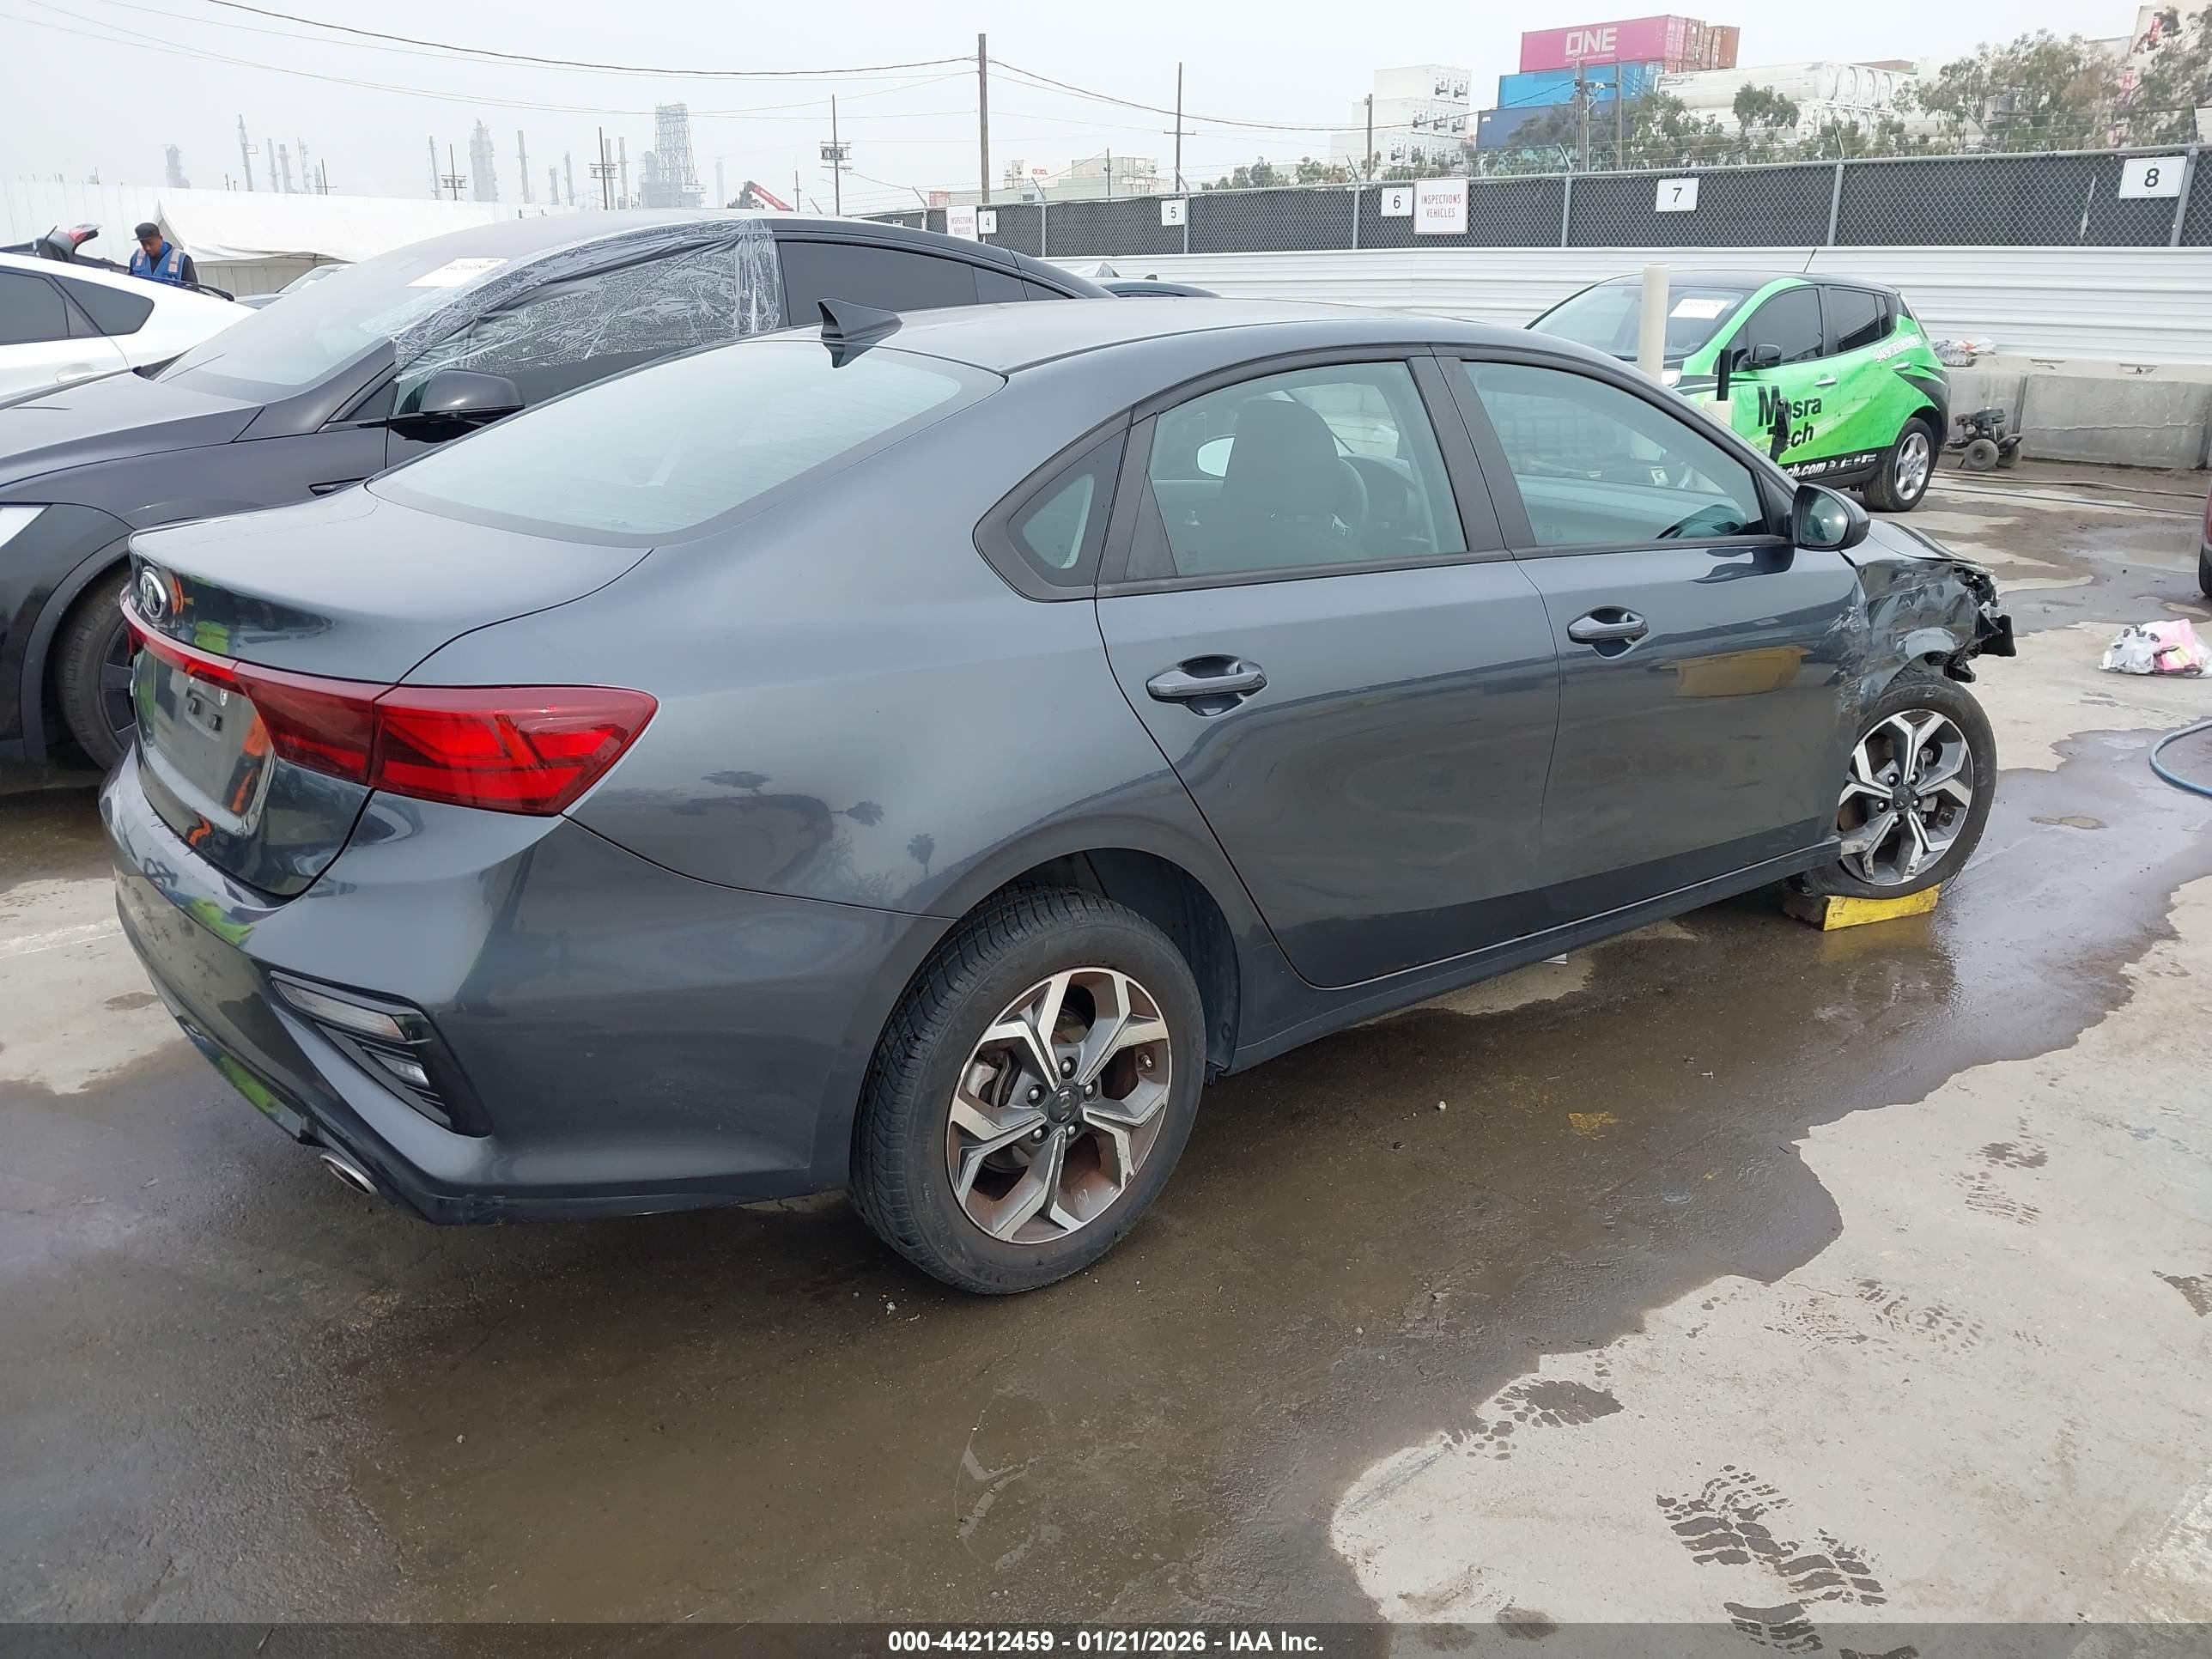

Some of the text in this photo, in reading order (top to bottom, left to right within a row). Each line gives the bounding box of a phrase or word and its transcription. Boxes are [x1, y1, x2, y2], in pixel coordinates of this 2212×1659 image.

[1565, 27, 1618, 56] ONE
[2144, 167, 2160, 188] 8
[1393, 194, 1401, 210] 6
[1421, 193, 1462, 205] INSPECTIONS
[1673, 187, 1683, 203] 7
[1170, 206, 1177, 219] 5
[1425, 207, 1455, 219] VEHICLES
[985, 216, 990, 228] 4
[1757, 385, 1822, 428] Msra
